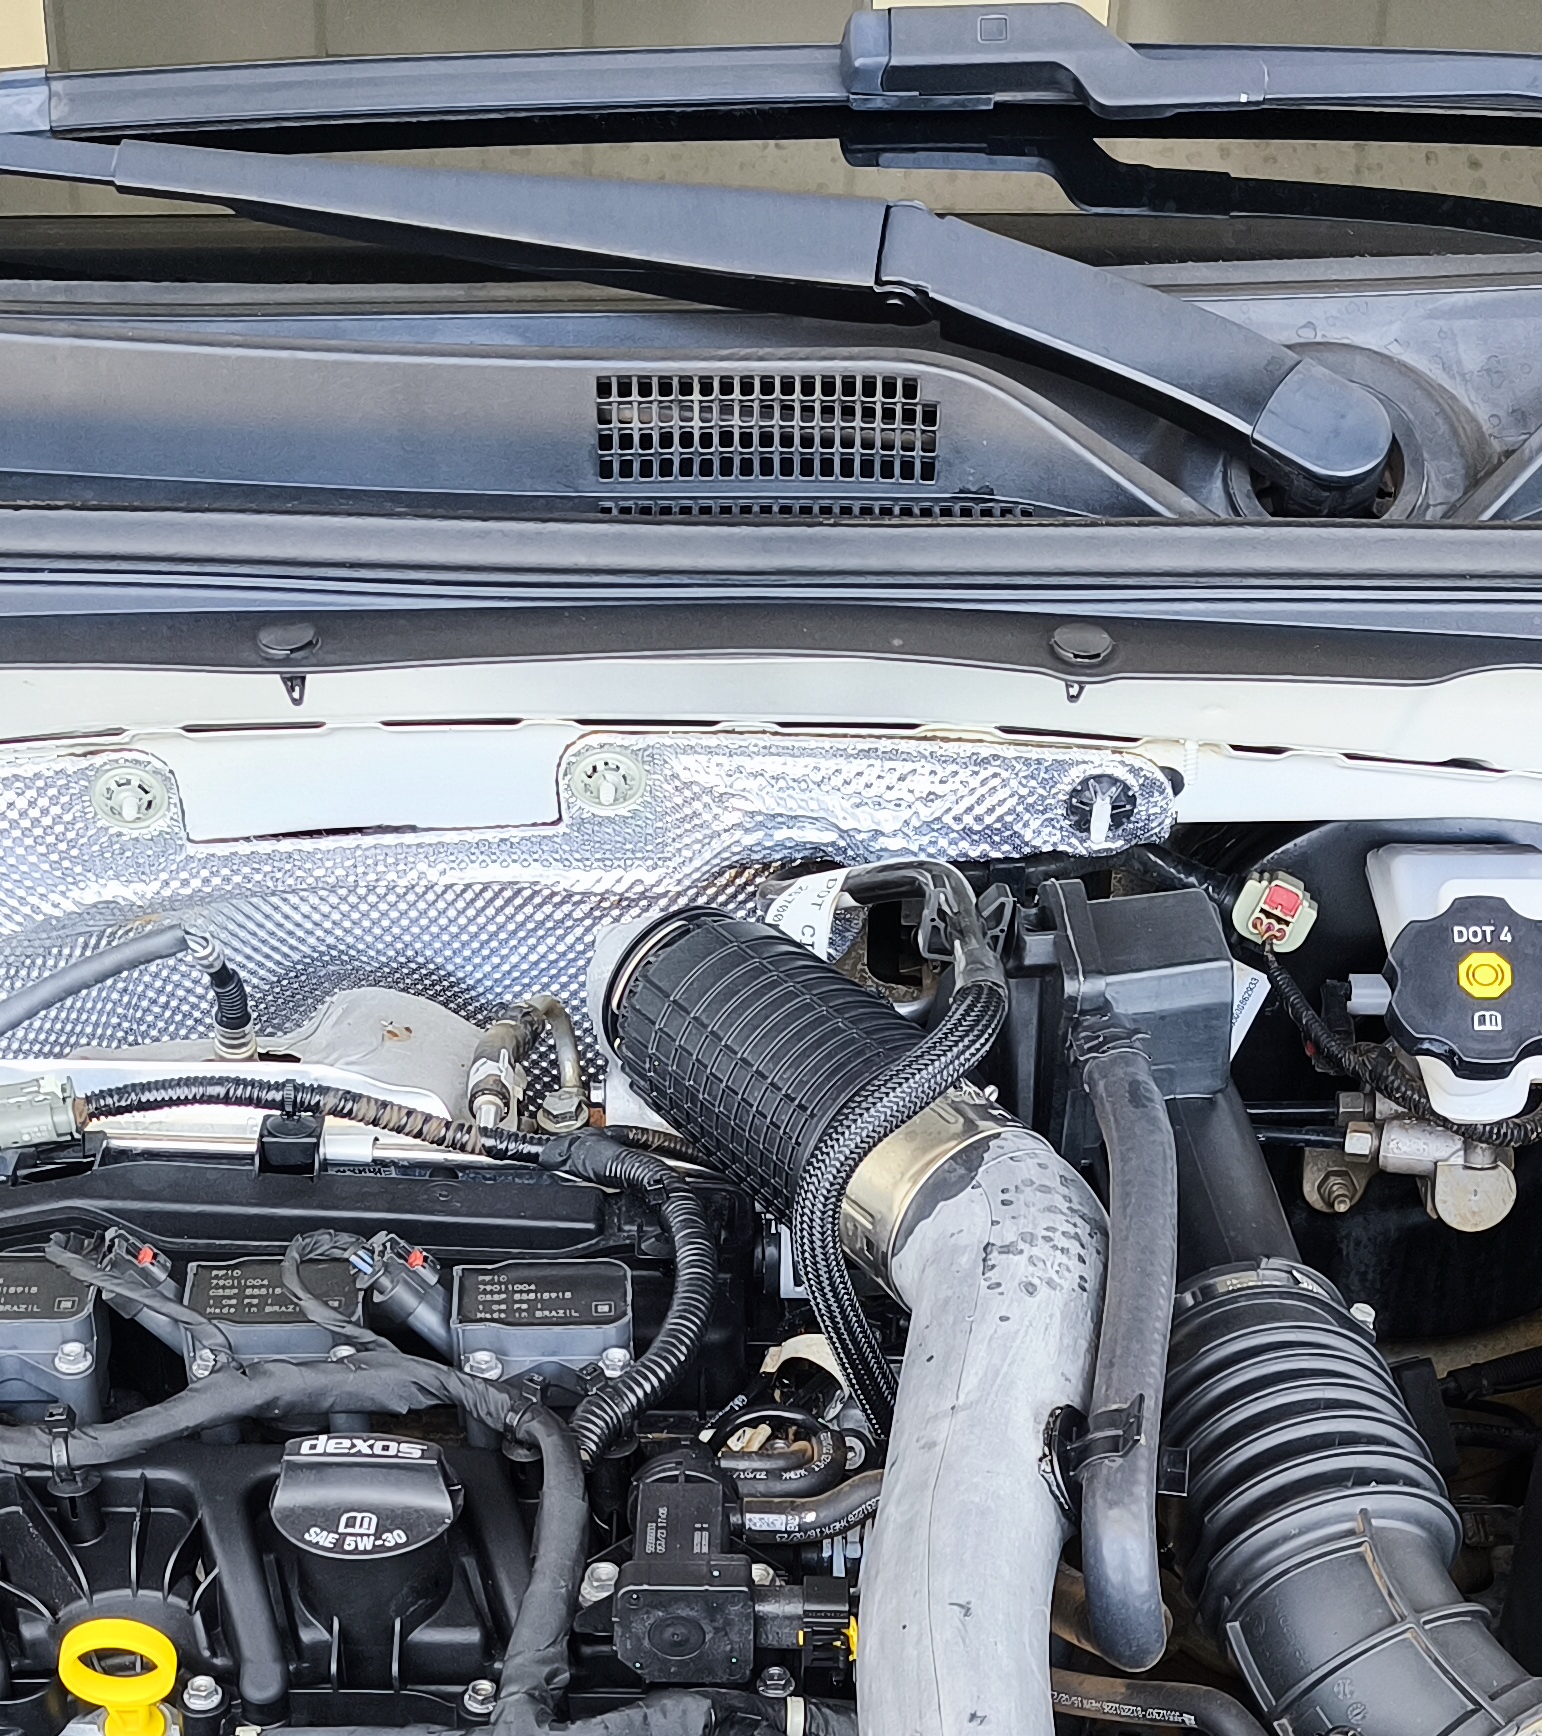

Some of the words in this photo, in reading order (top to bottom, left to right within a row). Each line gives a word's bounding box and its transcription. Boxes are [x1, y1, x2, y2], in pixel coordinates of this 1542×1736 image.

[1453, 926, 1495, 943] DOT
[1500, 926, 1512, 943] 4
[265, 1305, 300, 1313] BRAZI
[300, 1435, 428, 1459] dexos
[304, 1527, 339, 1548] SAE
[343, 1529, 408, 1550] 5W-30
